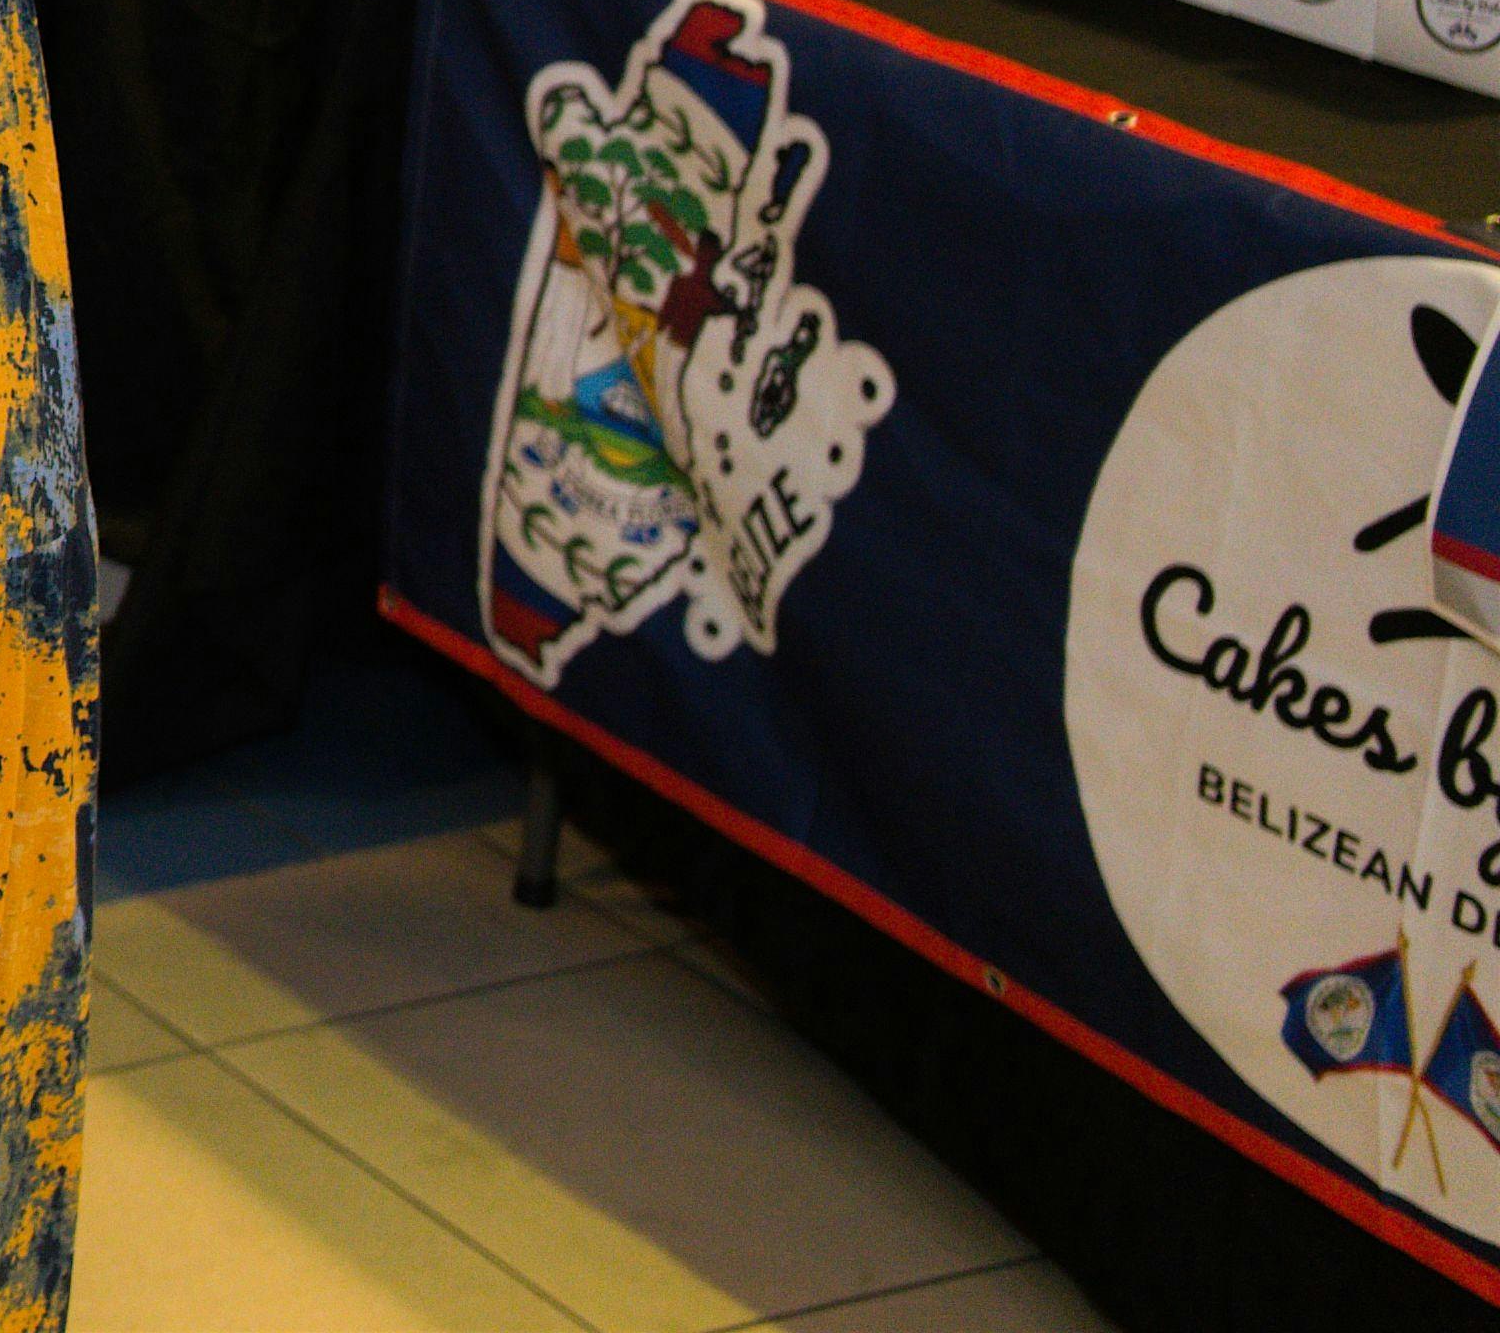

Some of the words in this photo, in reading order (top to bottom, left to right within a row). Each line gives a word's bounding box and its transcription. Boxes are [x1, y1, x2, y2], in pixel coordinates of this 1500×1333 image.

[1140, 563, 1418, 773] Cakes
[1438, 686, 1500, 888] b
[1196, 763, 1433, 912] BELIZEAN
